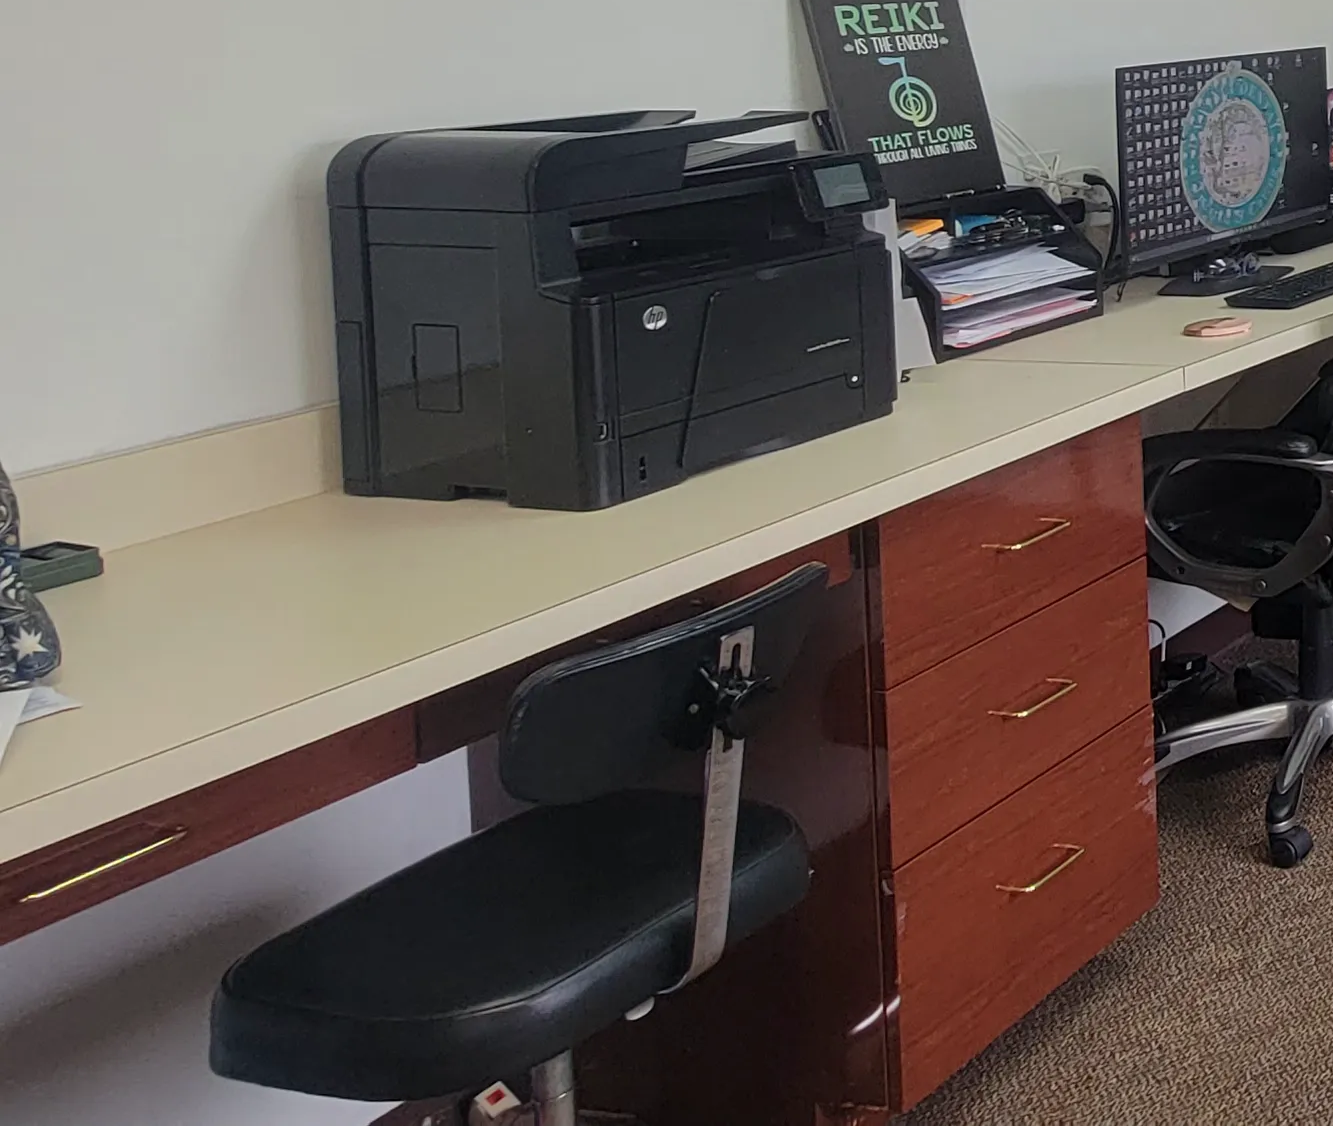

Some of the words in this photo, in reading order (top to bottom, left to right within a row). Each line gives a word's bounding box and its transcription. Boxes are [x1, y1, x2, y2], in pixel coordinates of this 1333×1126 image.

[833, 1, 945, 37] REIKI
[853, 37, 869, 55] IS
[870, 35, 895, 54] THE
[895, 32, 940, 52] ENERGY
[867, 132, 913, 153] THAT
[916, 123, 975, 146] FLOWS
[909, 146, 925, 161] ALL
[645, 306, 665, 330] hp
